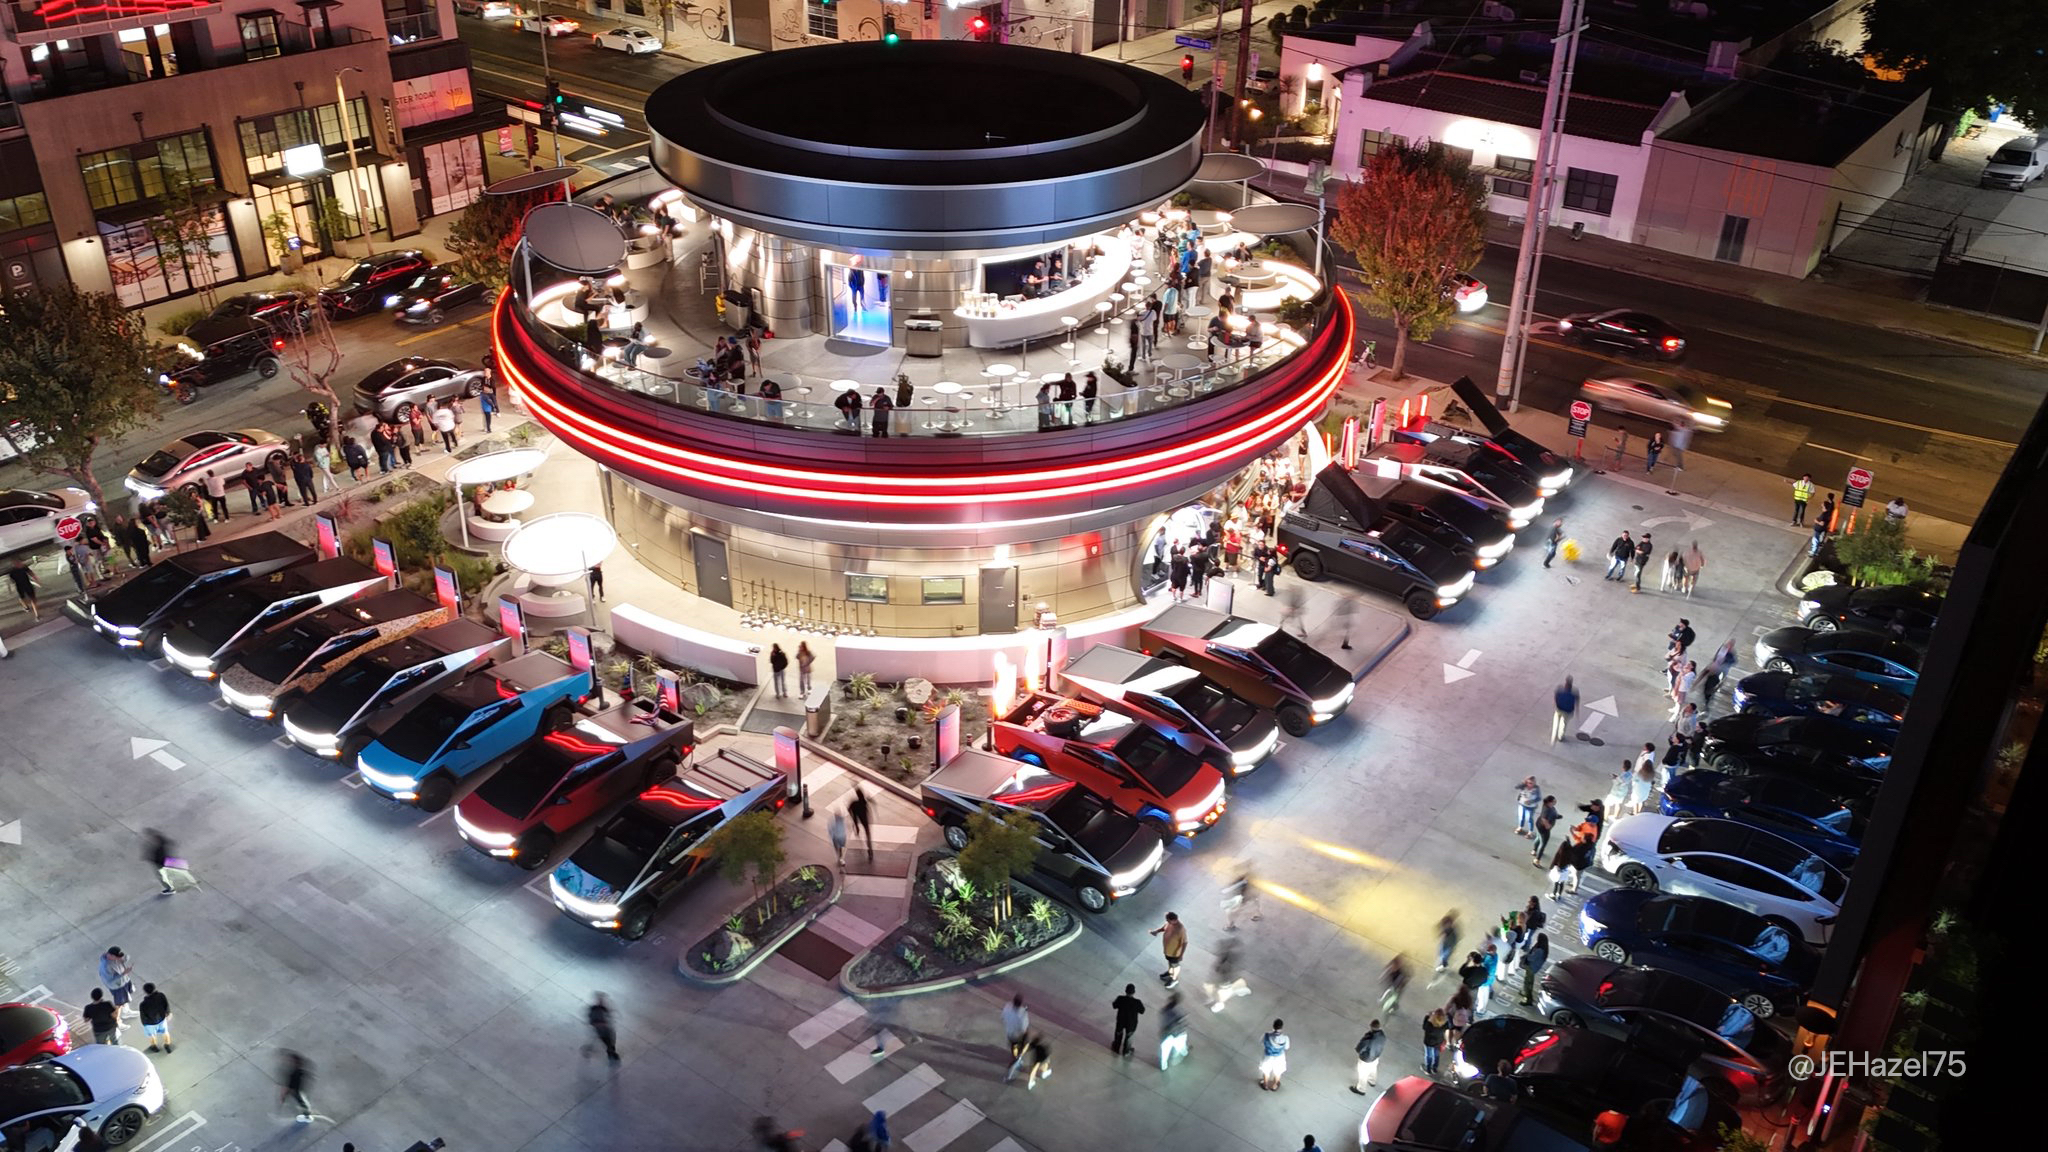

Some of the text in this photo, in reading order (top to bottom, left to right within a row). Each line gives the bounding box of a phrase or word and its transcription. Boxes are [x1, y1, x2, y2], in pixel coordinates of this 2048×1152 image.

[415, 90, 437, 101] TODAY
[1572, 405, 1590, 415] STOP
[1850, 473, 1869, 484] STOP
[58, 522, 80, 535] STOP
